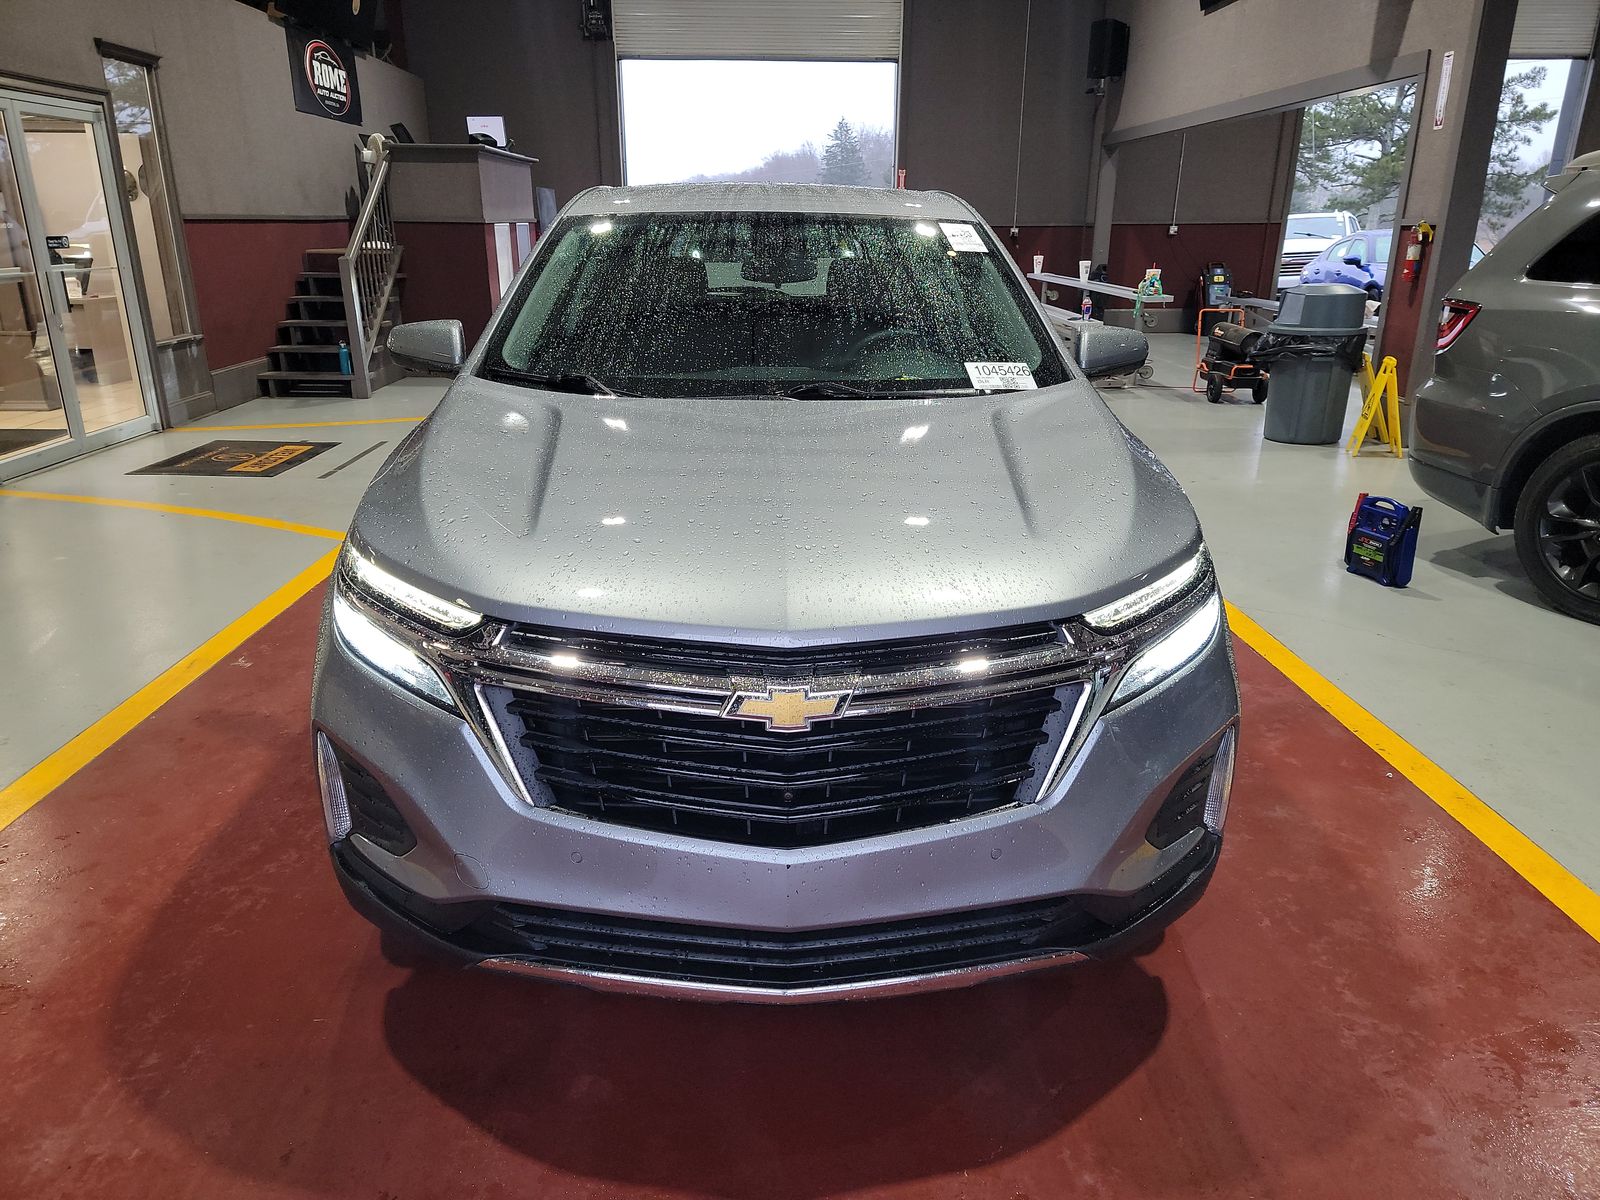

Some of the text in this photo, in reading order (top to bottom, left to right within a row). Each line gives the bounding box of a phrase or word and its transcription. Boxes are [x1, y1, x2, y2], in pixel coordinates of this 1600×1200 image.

[312, 60, 347, 93] ROME
[317, 88, 347, 102] AUTO AUCTION
[974, 365, 1031, 377] 1045426
